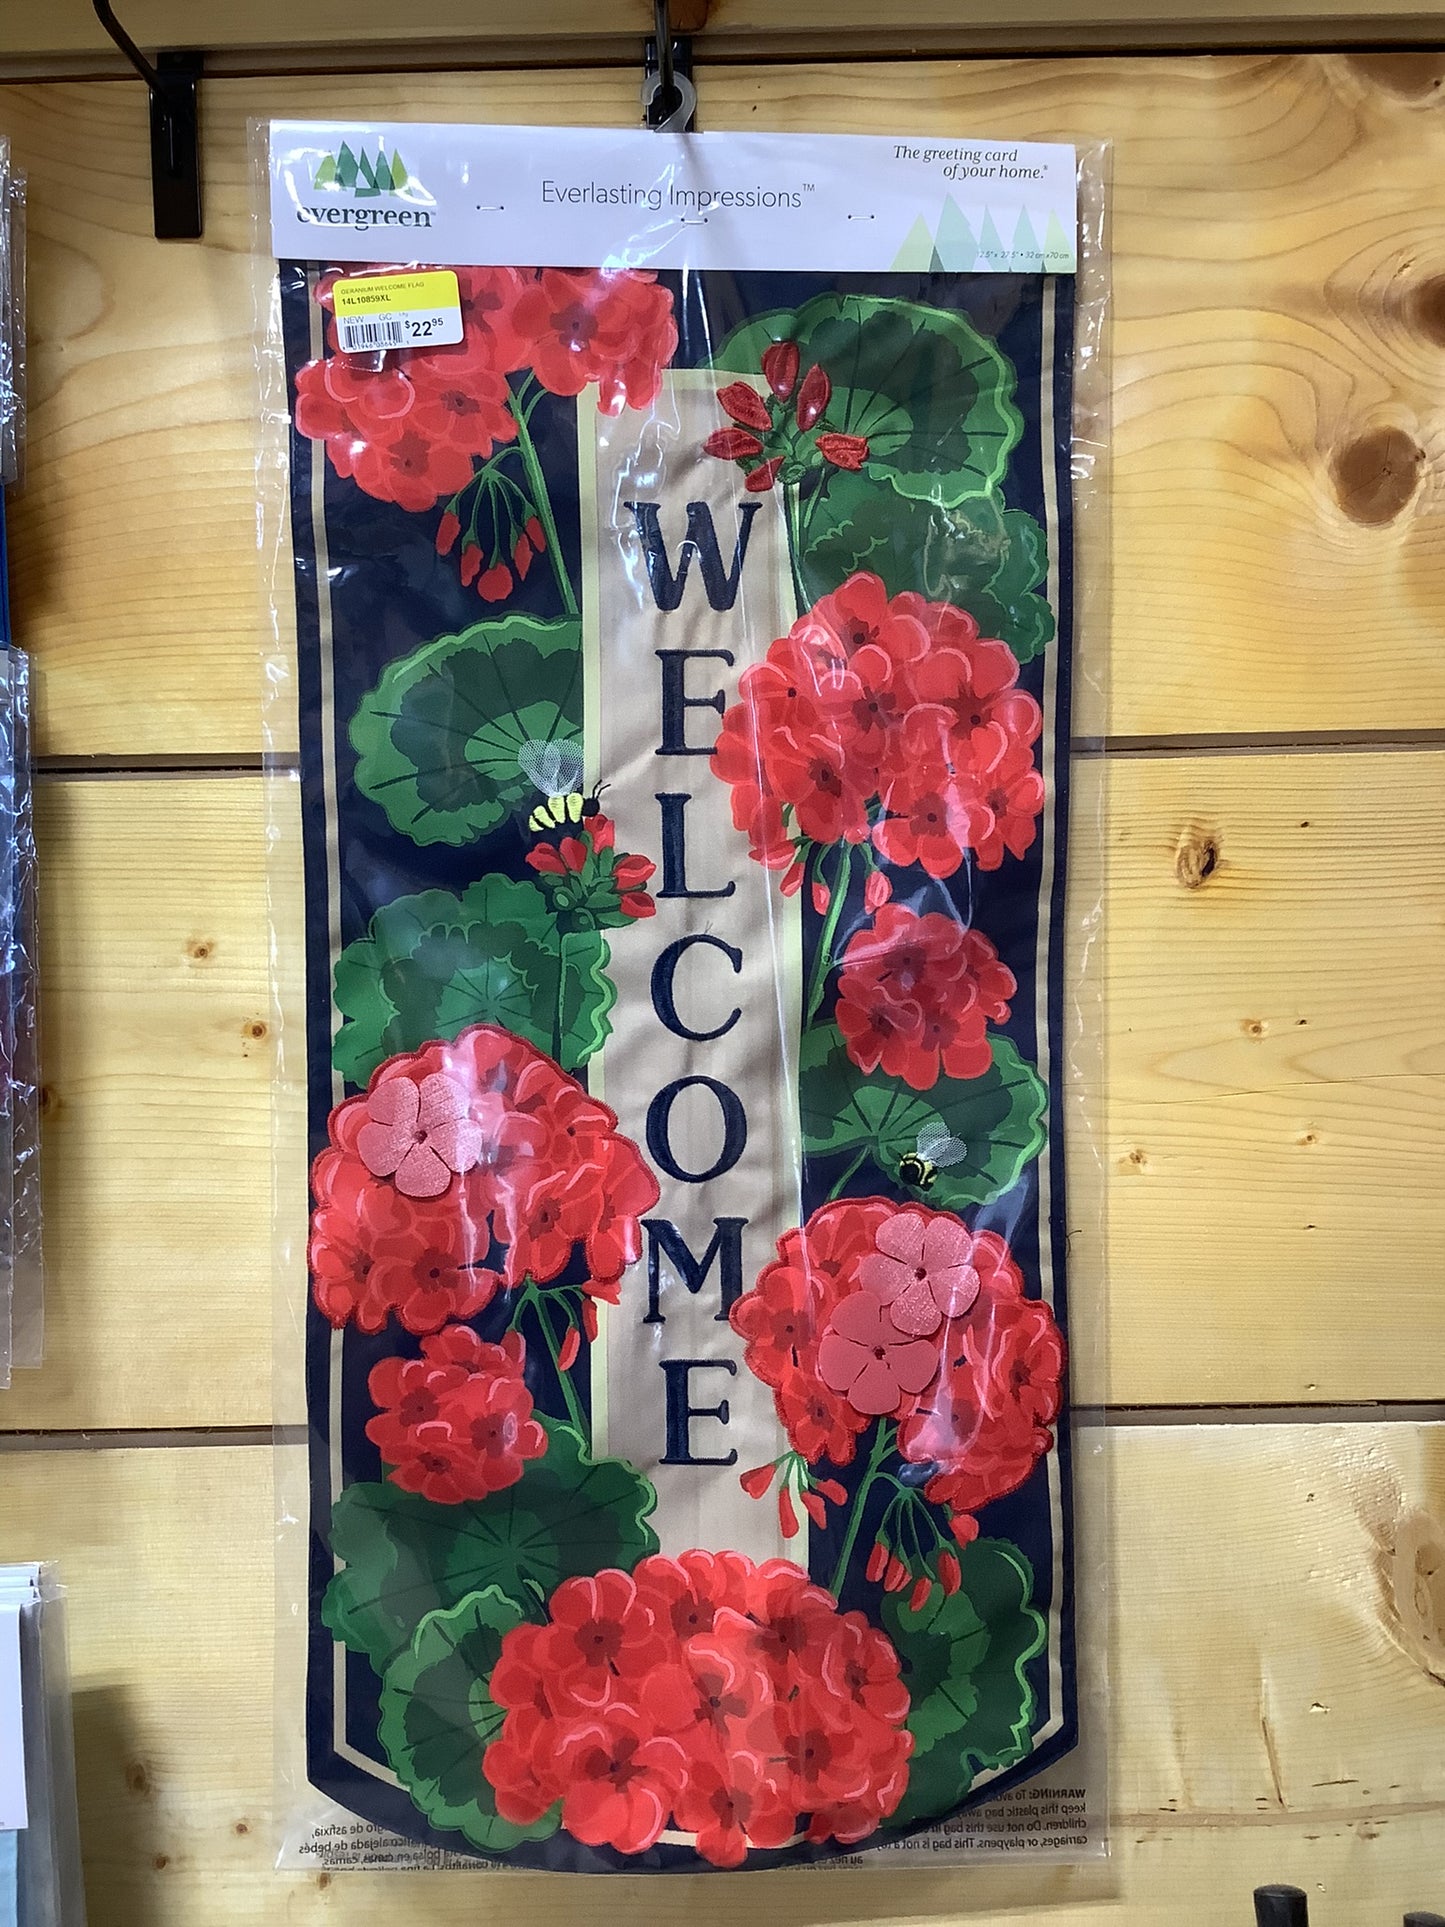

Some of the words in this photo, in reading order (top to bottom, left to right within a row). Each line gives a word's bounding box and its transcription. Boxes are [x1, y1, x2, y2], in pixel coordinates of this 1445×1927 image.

[894, 145, 920, 159] The
[922, 148, 983, 164] greeting
[984, 149, 1018, 162] card
[943, 163, 959, 180] of
[958, 166, 996, 180] your
[541, 180, 662, 210] Everlasting
[296, 206, 432, 232] evergreen
[341, 286, 374, 295] GERANIUM
[375, 283, 406, 292] WELCOME
[341, 294, 392, 305] 14L10859XL
[343, 315, 365, 324] NEW
[624, 500, 763, 1465] WELCOME
